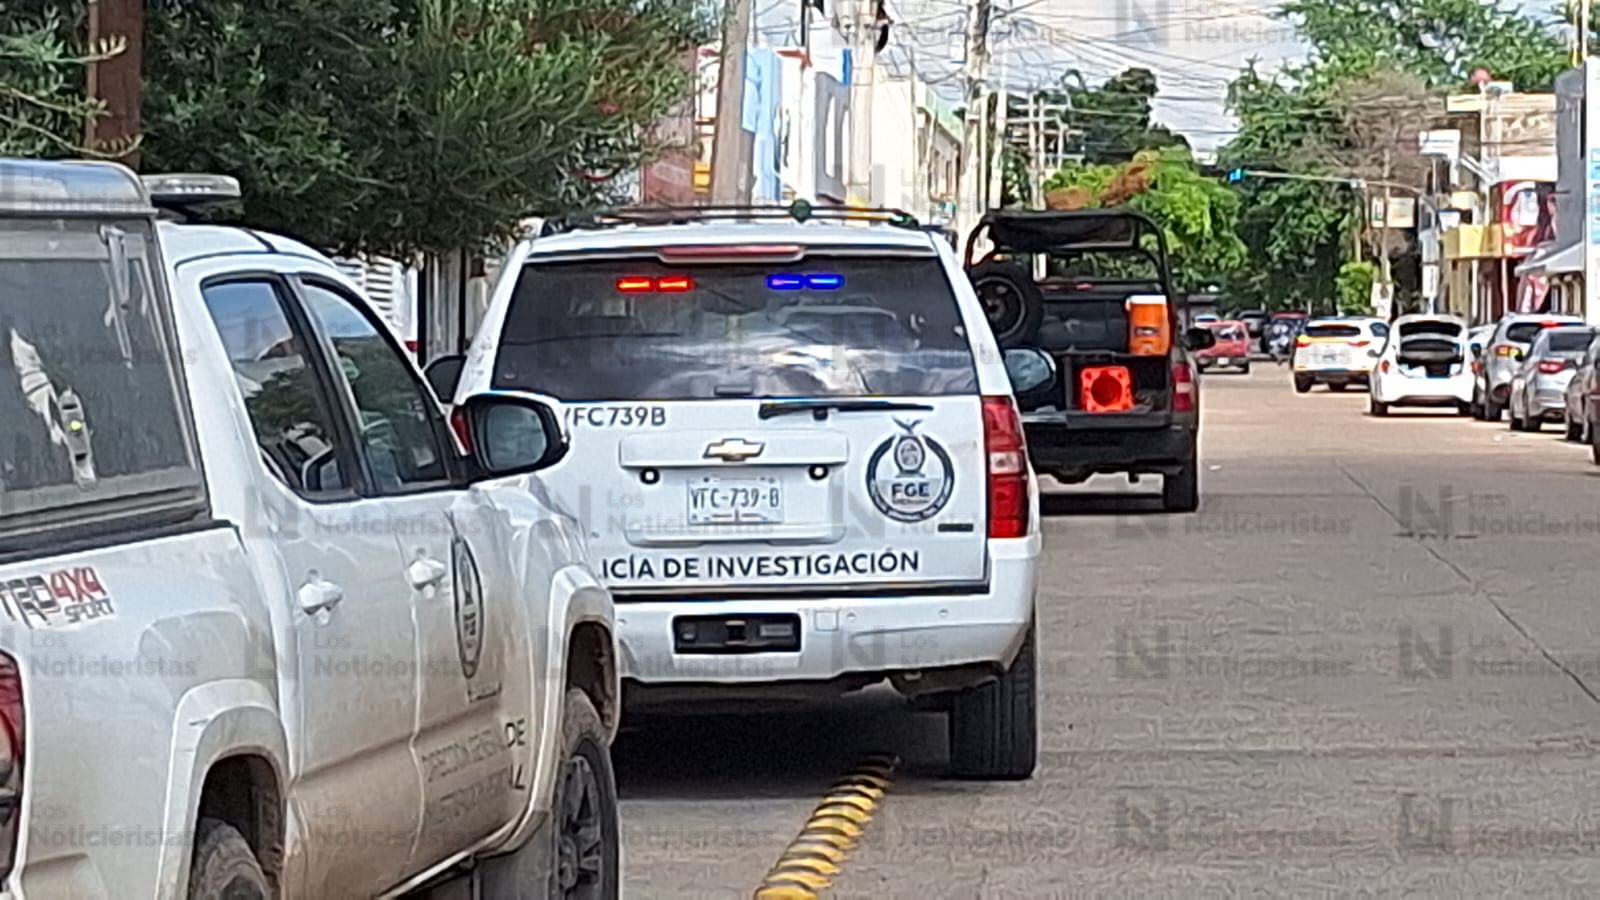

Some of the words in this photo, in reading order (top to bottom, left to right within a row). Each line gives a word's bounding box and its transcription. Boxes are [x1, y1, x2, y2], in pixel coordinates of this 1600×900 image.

[892, 482, 930, 498] FGE
[663, 557, 699, 578] DE
[708, 547, 919, 577] INVESTIGACIÓN
[51, 566, 107, 602] 4X4
[64, 598, 115, 623] SPORT
[504, 717, 526, 749] DE
